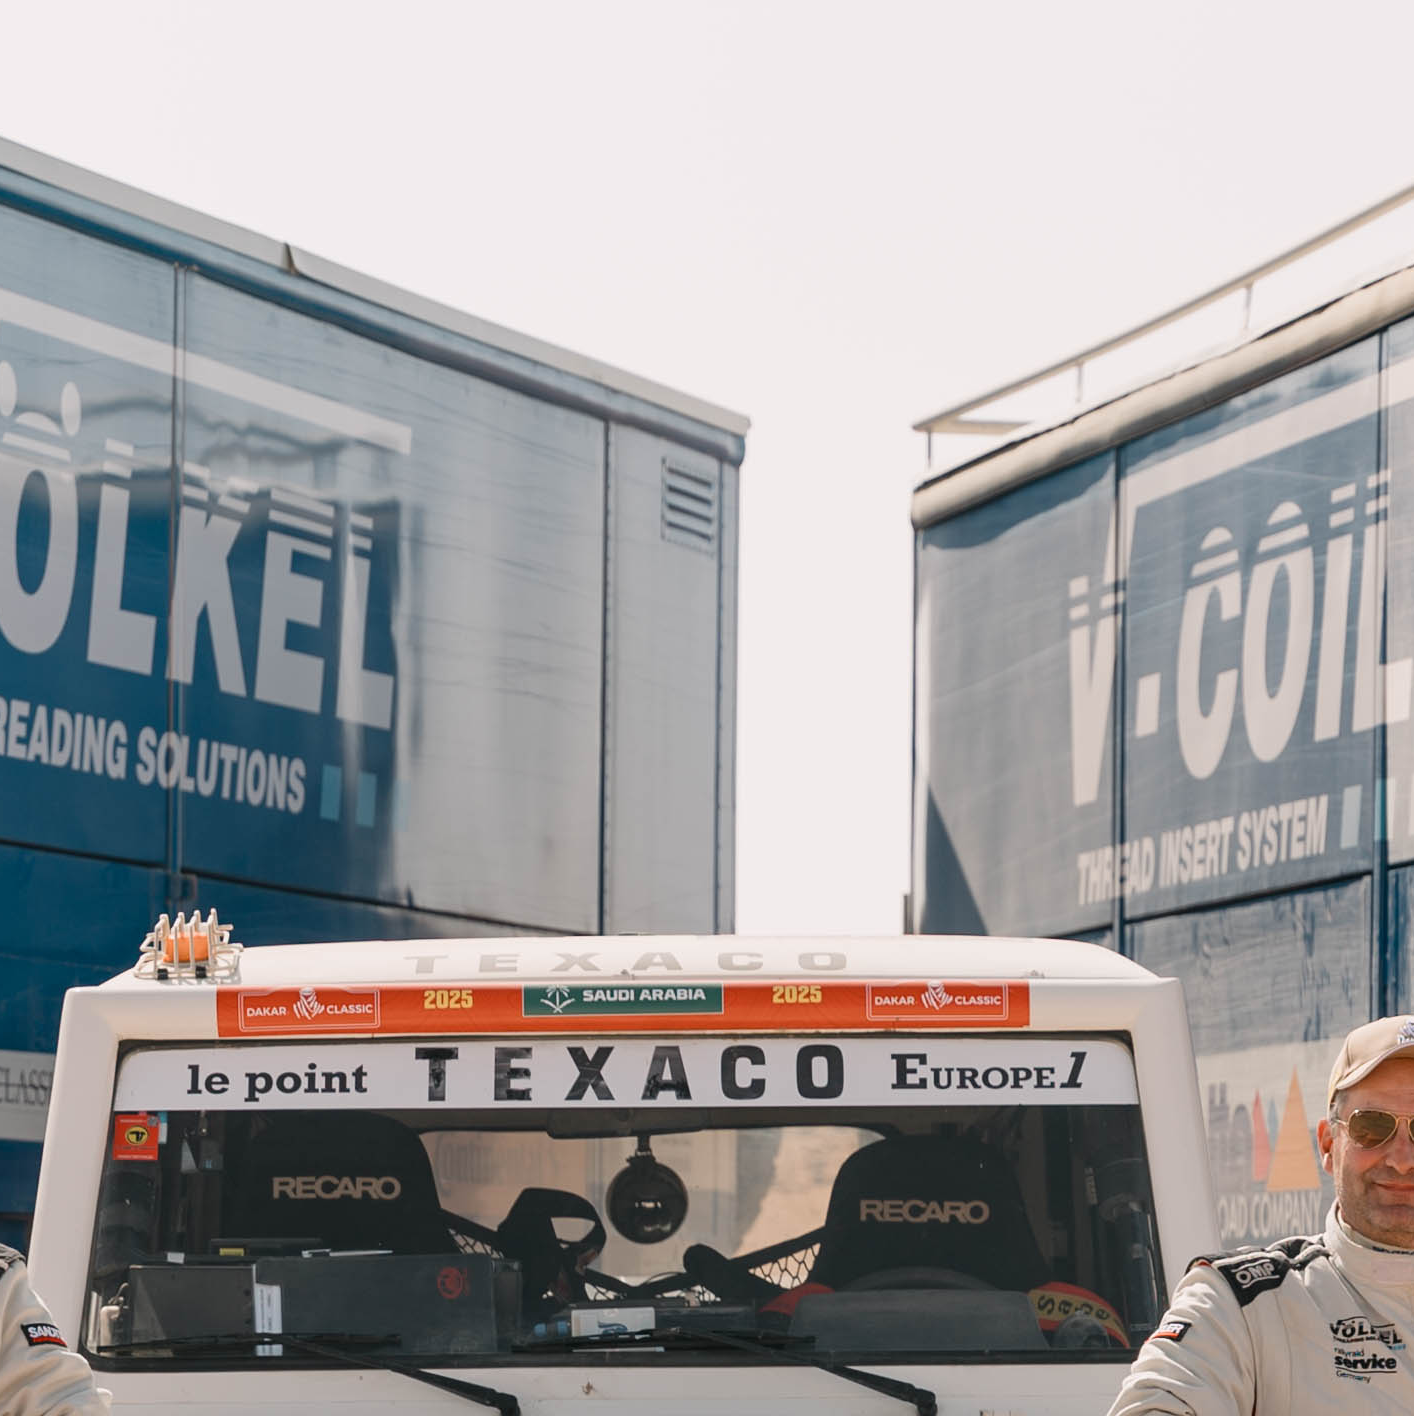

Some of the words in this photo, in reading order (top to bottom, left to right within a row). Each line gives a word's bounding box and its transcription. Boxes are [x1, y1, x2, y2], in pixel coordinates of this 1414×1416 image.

[137, 724, 306, 815] SOLUTIONS
[1077, 842, 1156, 907] THREAD
[1159, 820, 1235, 889] INSERT
[1236, 793, 1329, 873] SYSTEM
[404, 950, 847, 975] TEXACO
[424, 989, 473, 1010] 2025
[583, 988, 635, 1002] SAUDI
[640, 987, 706, 1001] ARABIA
[772, 985, 821, 1004] 2025
[874, 996, 915, 1006] DAKAR
[954, 995, 1002, 1006] CLASSIC
[246, 1005, 287, 1017] DAKAR
[326, 1003, 373, 1015] CLASSIC
[188, 1064, 229, 1095] le
[244, 1062, 368, 1102] point
[415, 1045, 844, 1101] TEXACO
[273, 1176, 402, 1200] RECARO
[859, 1199, 989, 1225] RECARO
[1251, 1189, 1323, 1239] COMPANY
[1235, 1262, 1275, 1284] OMP
[1334, 1353, 1397, 1369] service
